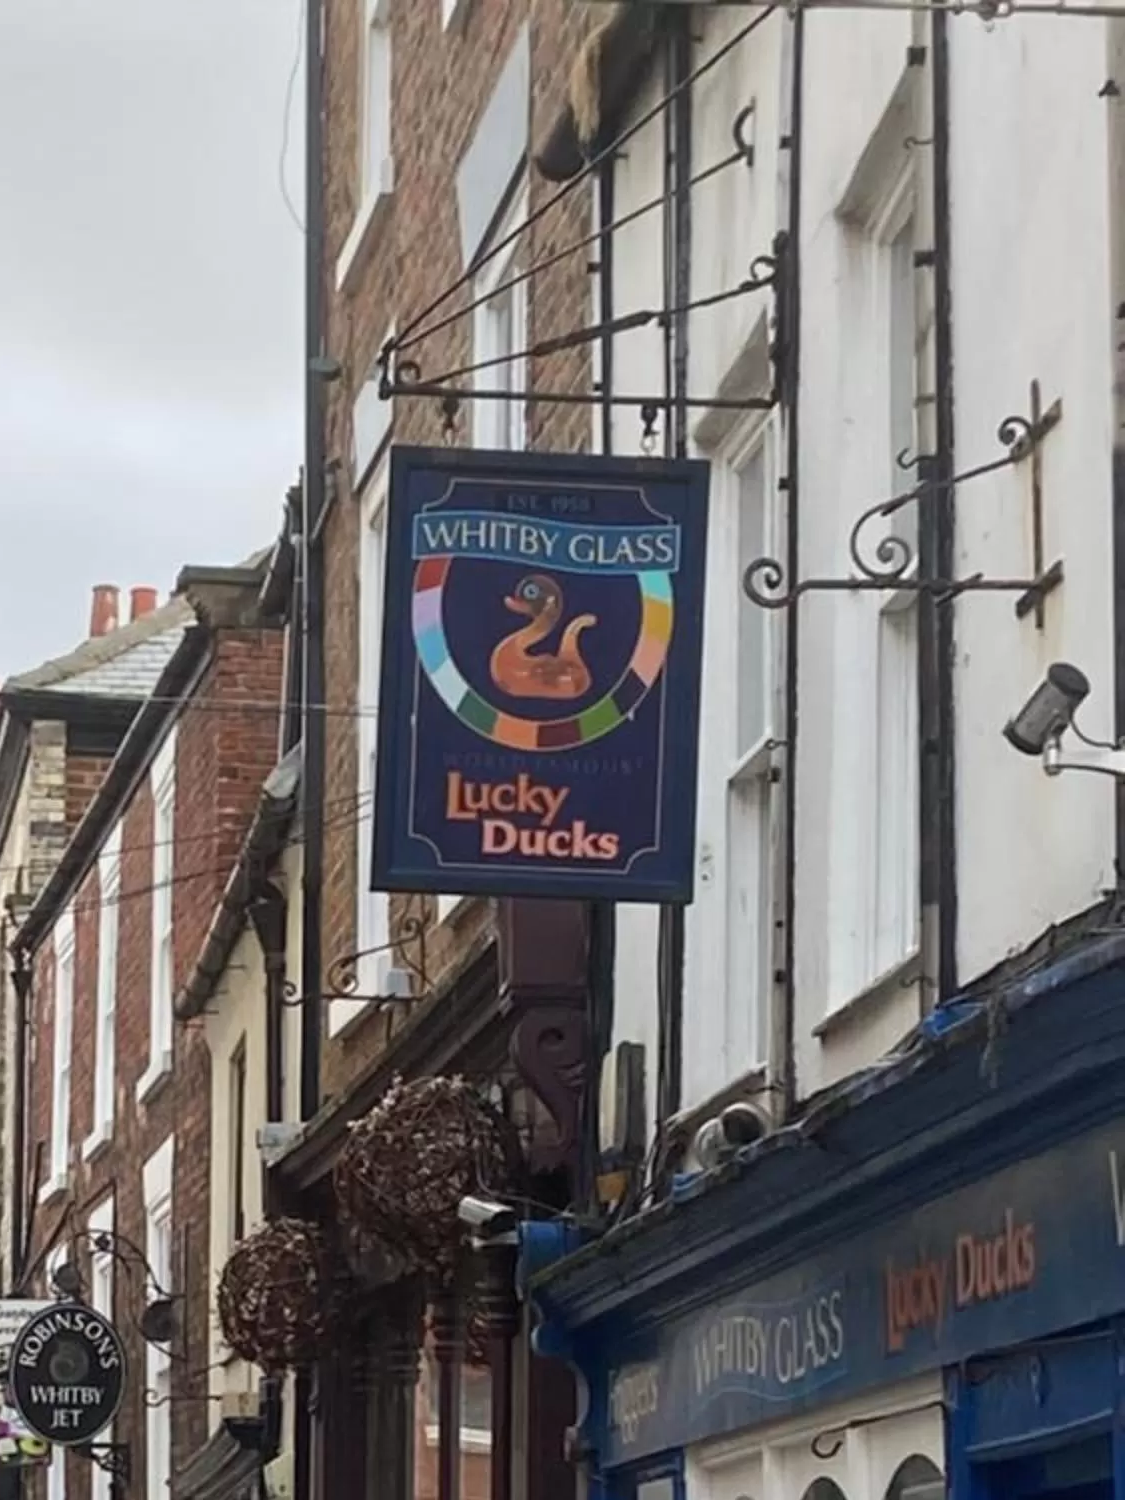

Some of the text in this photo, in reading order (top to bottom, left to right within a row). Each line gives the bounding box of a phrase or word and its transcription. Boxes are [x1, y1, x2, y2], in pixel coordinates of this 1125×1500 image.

[422, 521, 674, 565] WHITBY GLASS
[446, 771, 571, 827] Lucky
[481, 819, 620, 860] Ducks
[885, 1207, 1035, 1353] Lucky Ducks
[693, 1290, 844, 1397] WHITBY GLASS
[29, 1384, 105, 1406] WHITBY
[50, 1408, 85, 1429] JET
